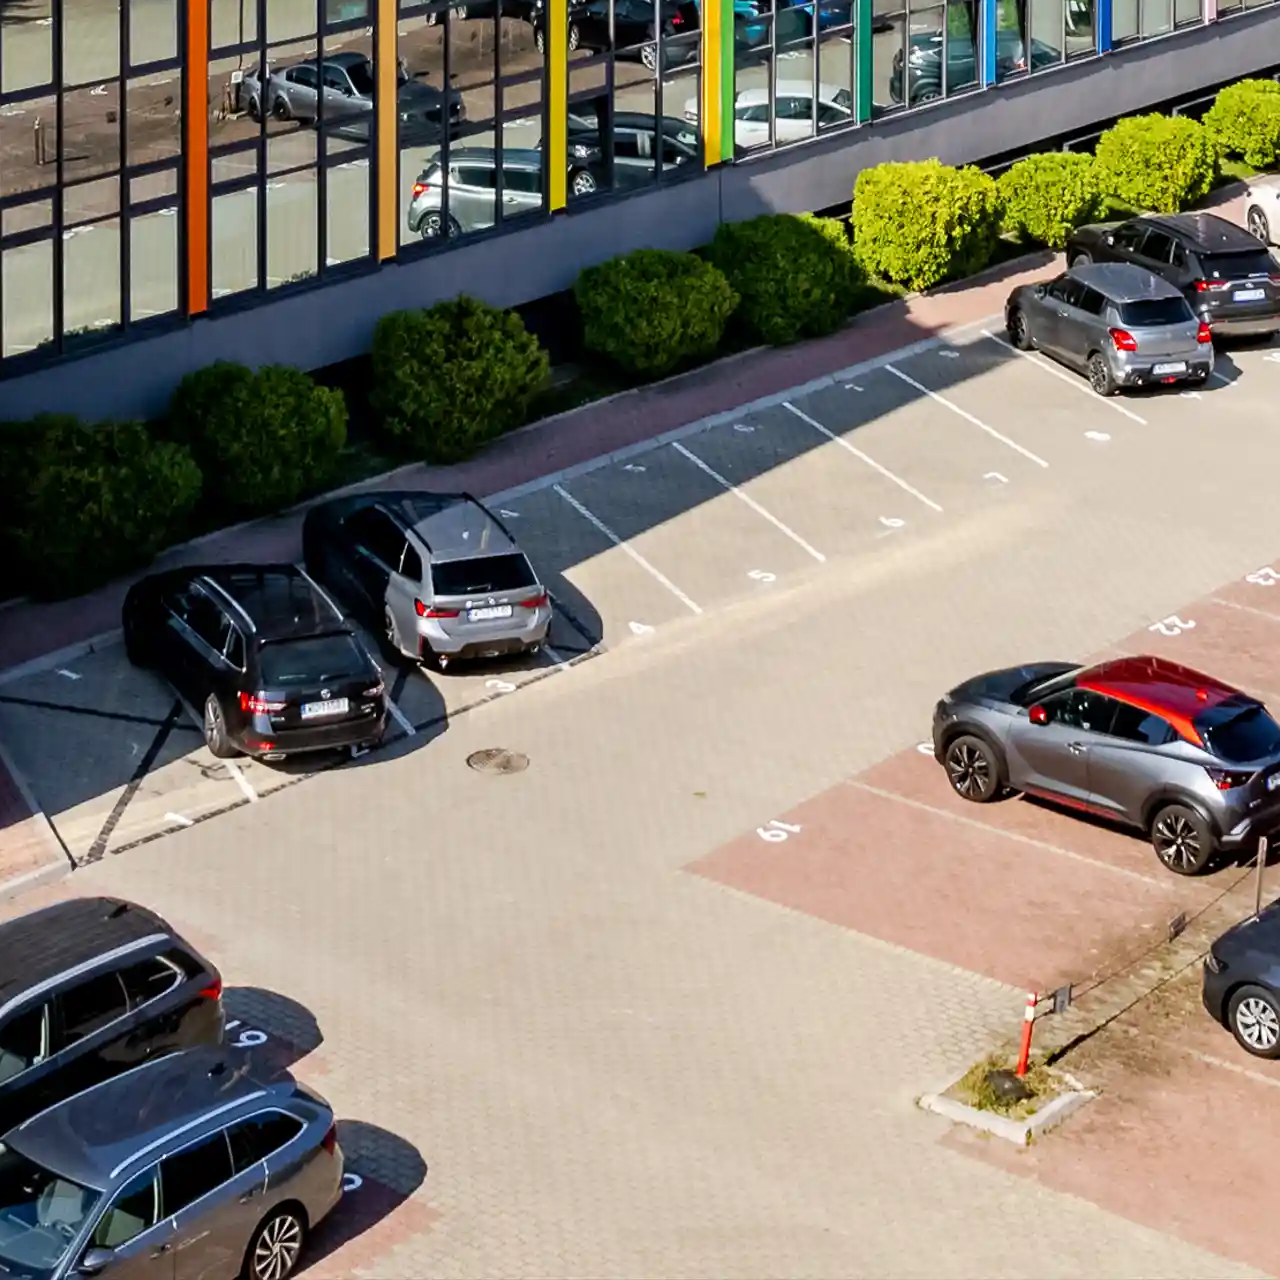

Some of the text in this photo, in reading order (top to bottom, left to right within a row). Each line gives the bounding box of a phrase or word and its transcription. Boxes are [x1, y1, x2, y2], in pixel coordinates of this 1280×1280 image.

[747, 569, 777, 582] 5
[628, 621, 656, 635] 4
[1148, 615, 1196, 635] 22
[485, 679, 516, 693] 3
[756, 819, 802, 843] 19
